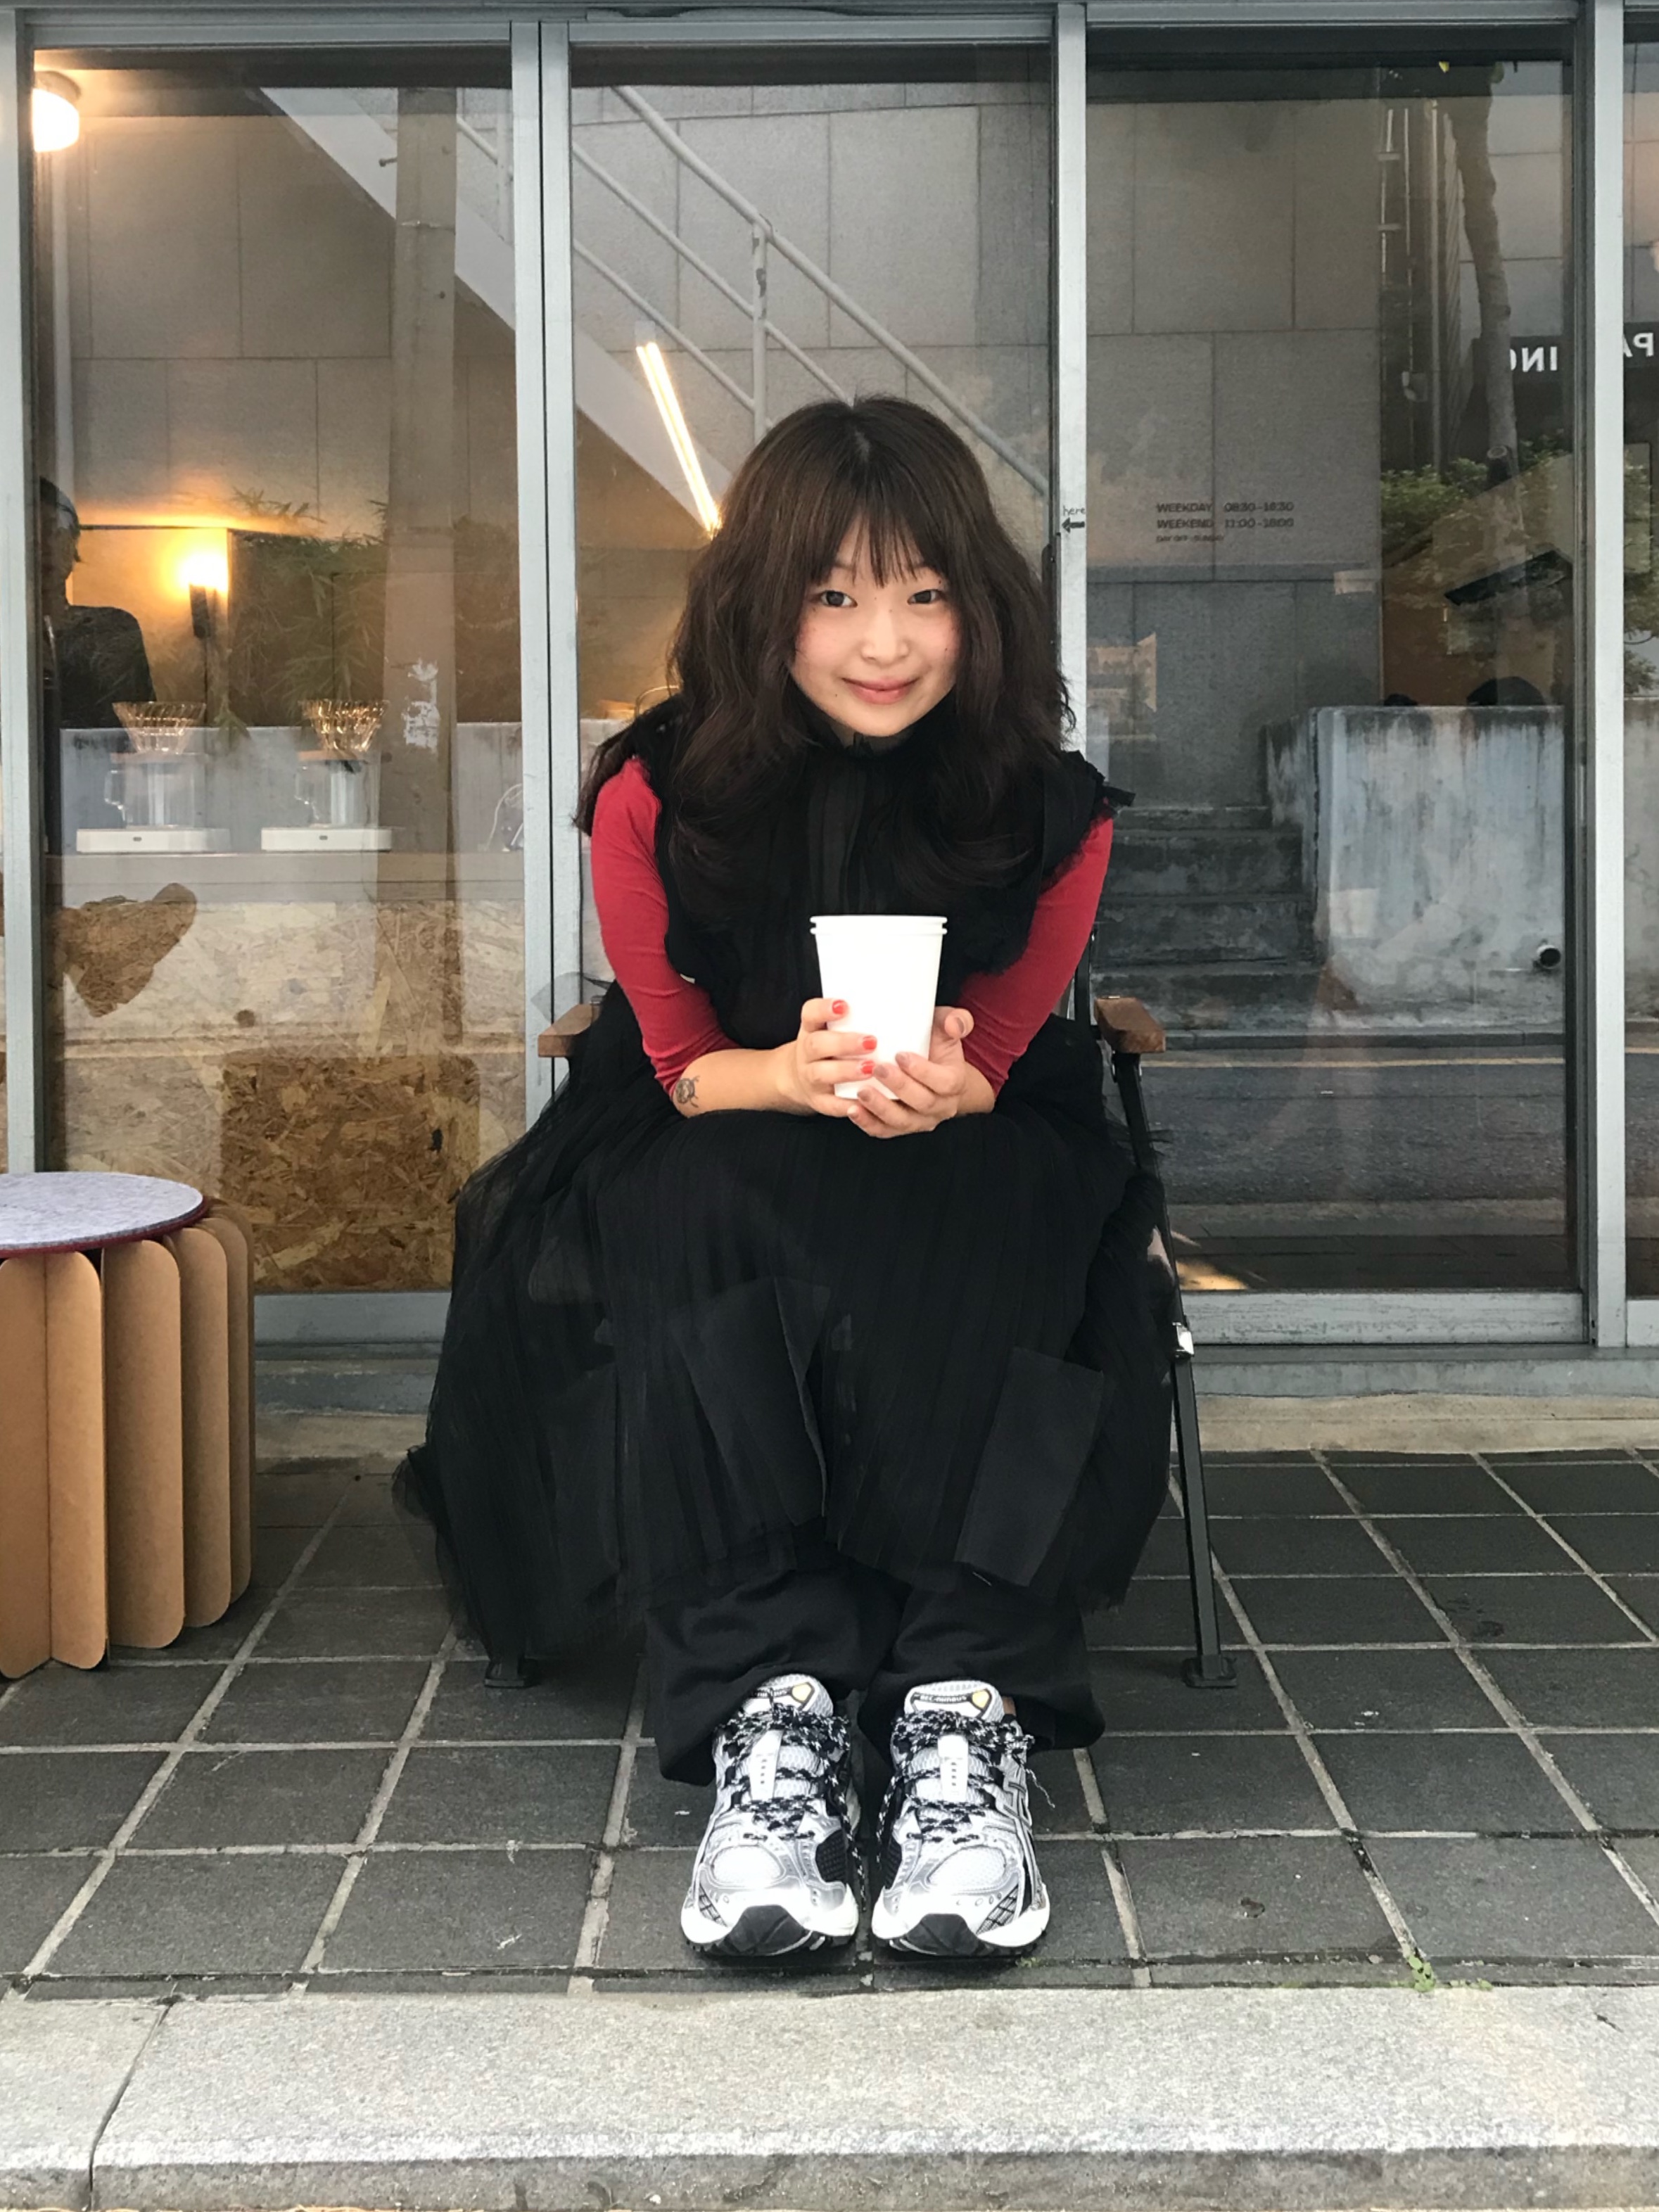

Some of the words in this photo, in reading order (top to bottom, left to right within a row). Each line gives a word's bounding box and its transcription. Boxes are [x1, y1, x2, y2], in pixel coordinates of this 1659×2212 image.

[1062, 504, 1086, 516] here
[1156, 502, 1214, 513] WEEKDAY
[1157, 519, 1215, 529] WEEKEND
